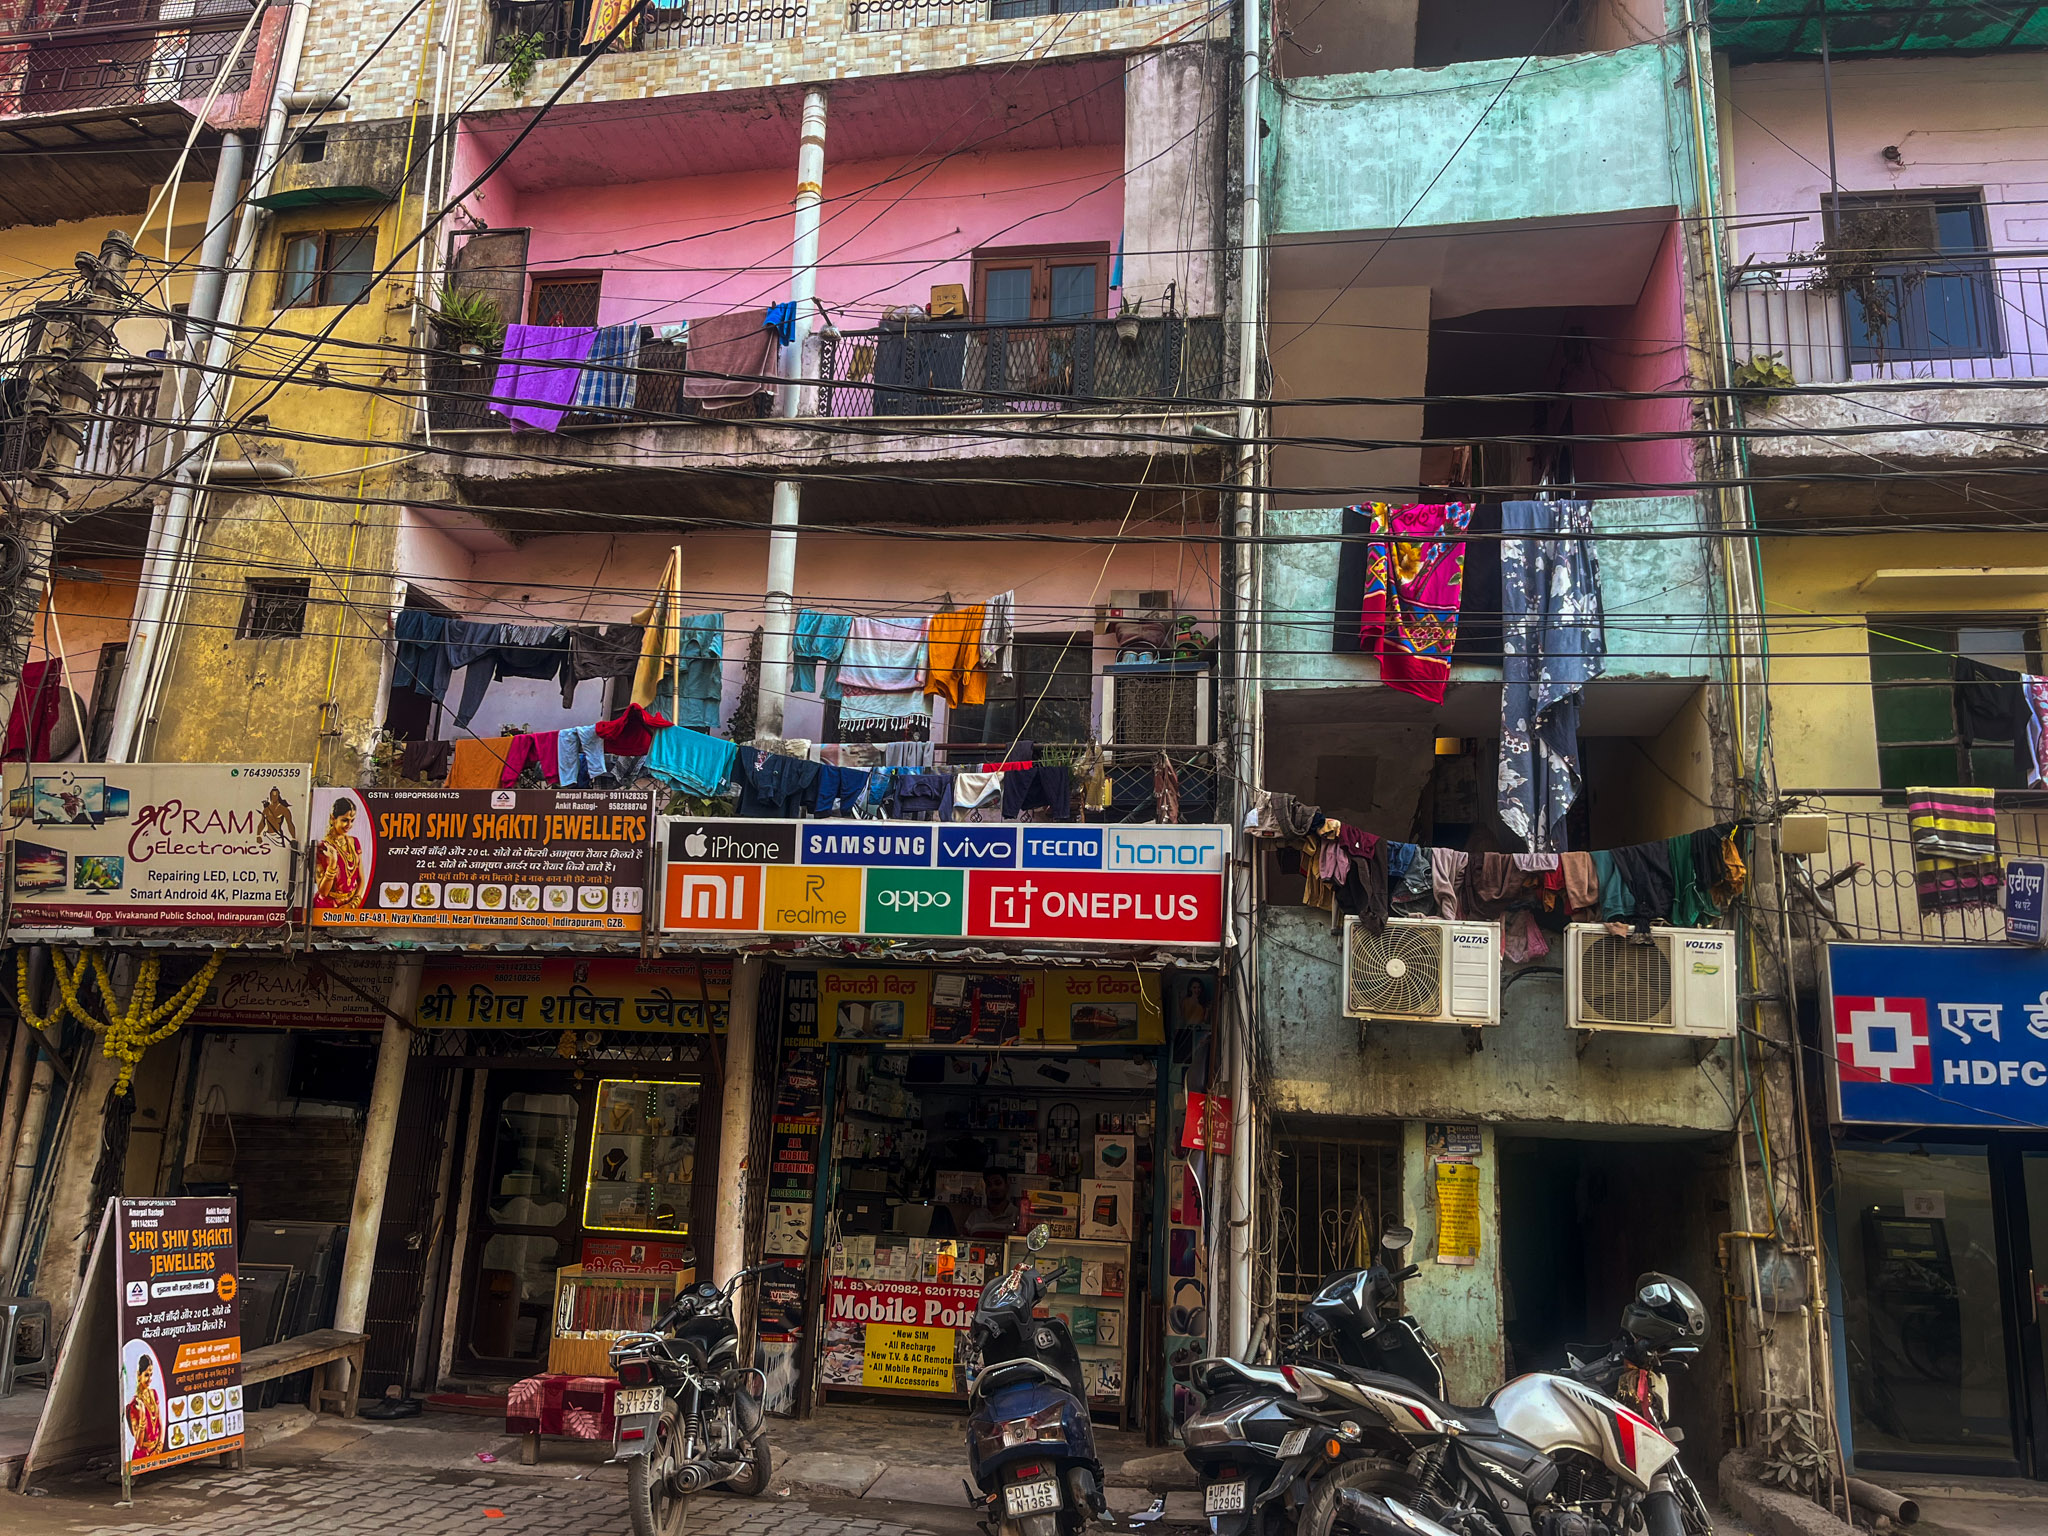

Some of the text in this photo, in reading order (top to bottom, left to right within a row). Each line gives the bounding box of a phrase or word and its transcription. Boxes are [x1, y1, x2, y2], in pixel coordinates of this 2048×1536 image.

[243, 768, 300, 777] 7643905359
[556, 792, 581, 800] Amarpal
[555, 802, 572, 810] Ankit
[183, 809, 253, 834] RAM
[380, 813, 646, 845] SHRI SHIV SHAKTI JEWELLERS
[155, 837, 271, 855] Electronics
[711, 835, 779, 860] iPhone
[809, 834, 925, 856] SAMSUNG
[942, 837, 1011, 858] vivo
[1027, 839, 1098, 857] TECNO
[1115, 834, 1215, 865] honor
[388, 845, 409, 856] हमारे
[448, 845, 466, 856] और
[467, 848, 478, 856] 20
[550, 849, 584, 860] आभूषण
[586, 848, 608, 858] तैयार
[610, 848, 635, 859] मिलते
[416, 860, 425, 868] 22
[427, 860, 437, 868] ct.
[469, 861, 503, 871] आभूषण
[530, 862, 541, 870] पर
[543, 861, 563, 870] तैयार
[148, 870, 279, 883] Repairing LED, LCD, TV,
[419, 872, 435, 881] हमारे
[2008, 867, 2042, 896] एटीएम
[130, 888, 271, 901] Smart Android 4K, Plazma
[878, 889, 951, 913] oppo
[1042, 891, 1198, 920] ONEPLUS
[96, 911, 113, 920] Opp.
[115, 911, 158, 920] Vivakanand
[160, 911, 184, 920] Public
[186, 912, 215, 921] School,
[217, 912, 264, 922] Indirapuram
[323, 912, 625, 928] Shop No. GF-481, Nyay Khand-III, Near Vivekanand School, Indirapuram, GZB.
[777, 905, 846, 925] realme
[1453, 935, 1489, 944] VOLTAS
[1685, 941, 1723, 949] VOLTAS
[256, 976, 301, 993] RAM
[825, 975, 918, 995] बिजली बिल
[1065, 976, 1093, 995] रेल
[239, 995, 310, 1007] Electronics
[331, 993, 354, 1002] Smart
[418, 984, 457, 1022] श्री
[468, 984, 529, 1022] शिव
[540, 985, 624, 1025] शक्ति
[342, 1004, 369, 1013] plazma
[797, 1025, 811, 1035] ALL
[1938, 1003, 2003, 1045] एच
[1943, 1060, 2047, 1086] HDFC
[777, 1122, 817, 1135] REMOTE
[1196, 1117, 1228, 1129] Atel
[788, 1137, 802, 1148] ALL
[779, 1150, 809, 1161] MOBILE
[773, 1162, 815, 1174] REPAIRING
[770, 1188, 813, 1198] ACCESSORIES
[1050, 1223, 1073, 1234] REPAIR
[129, 1227, 233, 1252] SHRI SHIV SHAKTI
[150, 1252, 215, 1278] JEWELLERS
[834, 1281, 847, 1290] M.
[925, 1286, 981, 1299] 62017935
[831, 1294, 917, 1324] Mobile
[896, 1330, 929, 1340] New SIM
[888, 1341, 936, 1352] All Recharge
[871, 1351, 952, 1365] New T.V. & AC Remote
[873, 1362, 948, 1377] All Mobile Repairing
[883, 1375, 939, 1387] All Accessories
[619, 1399, 660, 1414] BX1378
[1214, 1483, 1244, 1497] UP14F
[1213, 1496, 1241, 1510] 02909
